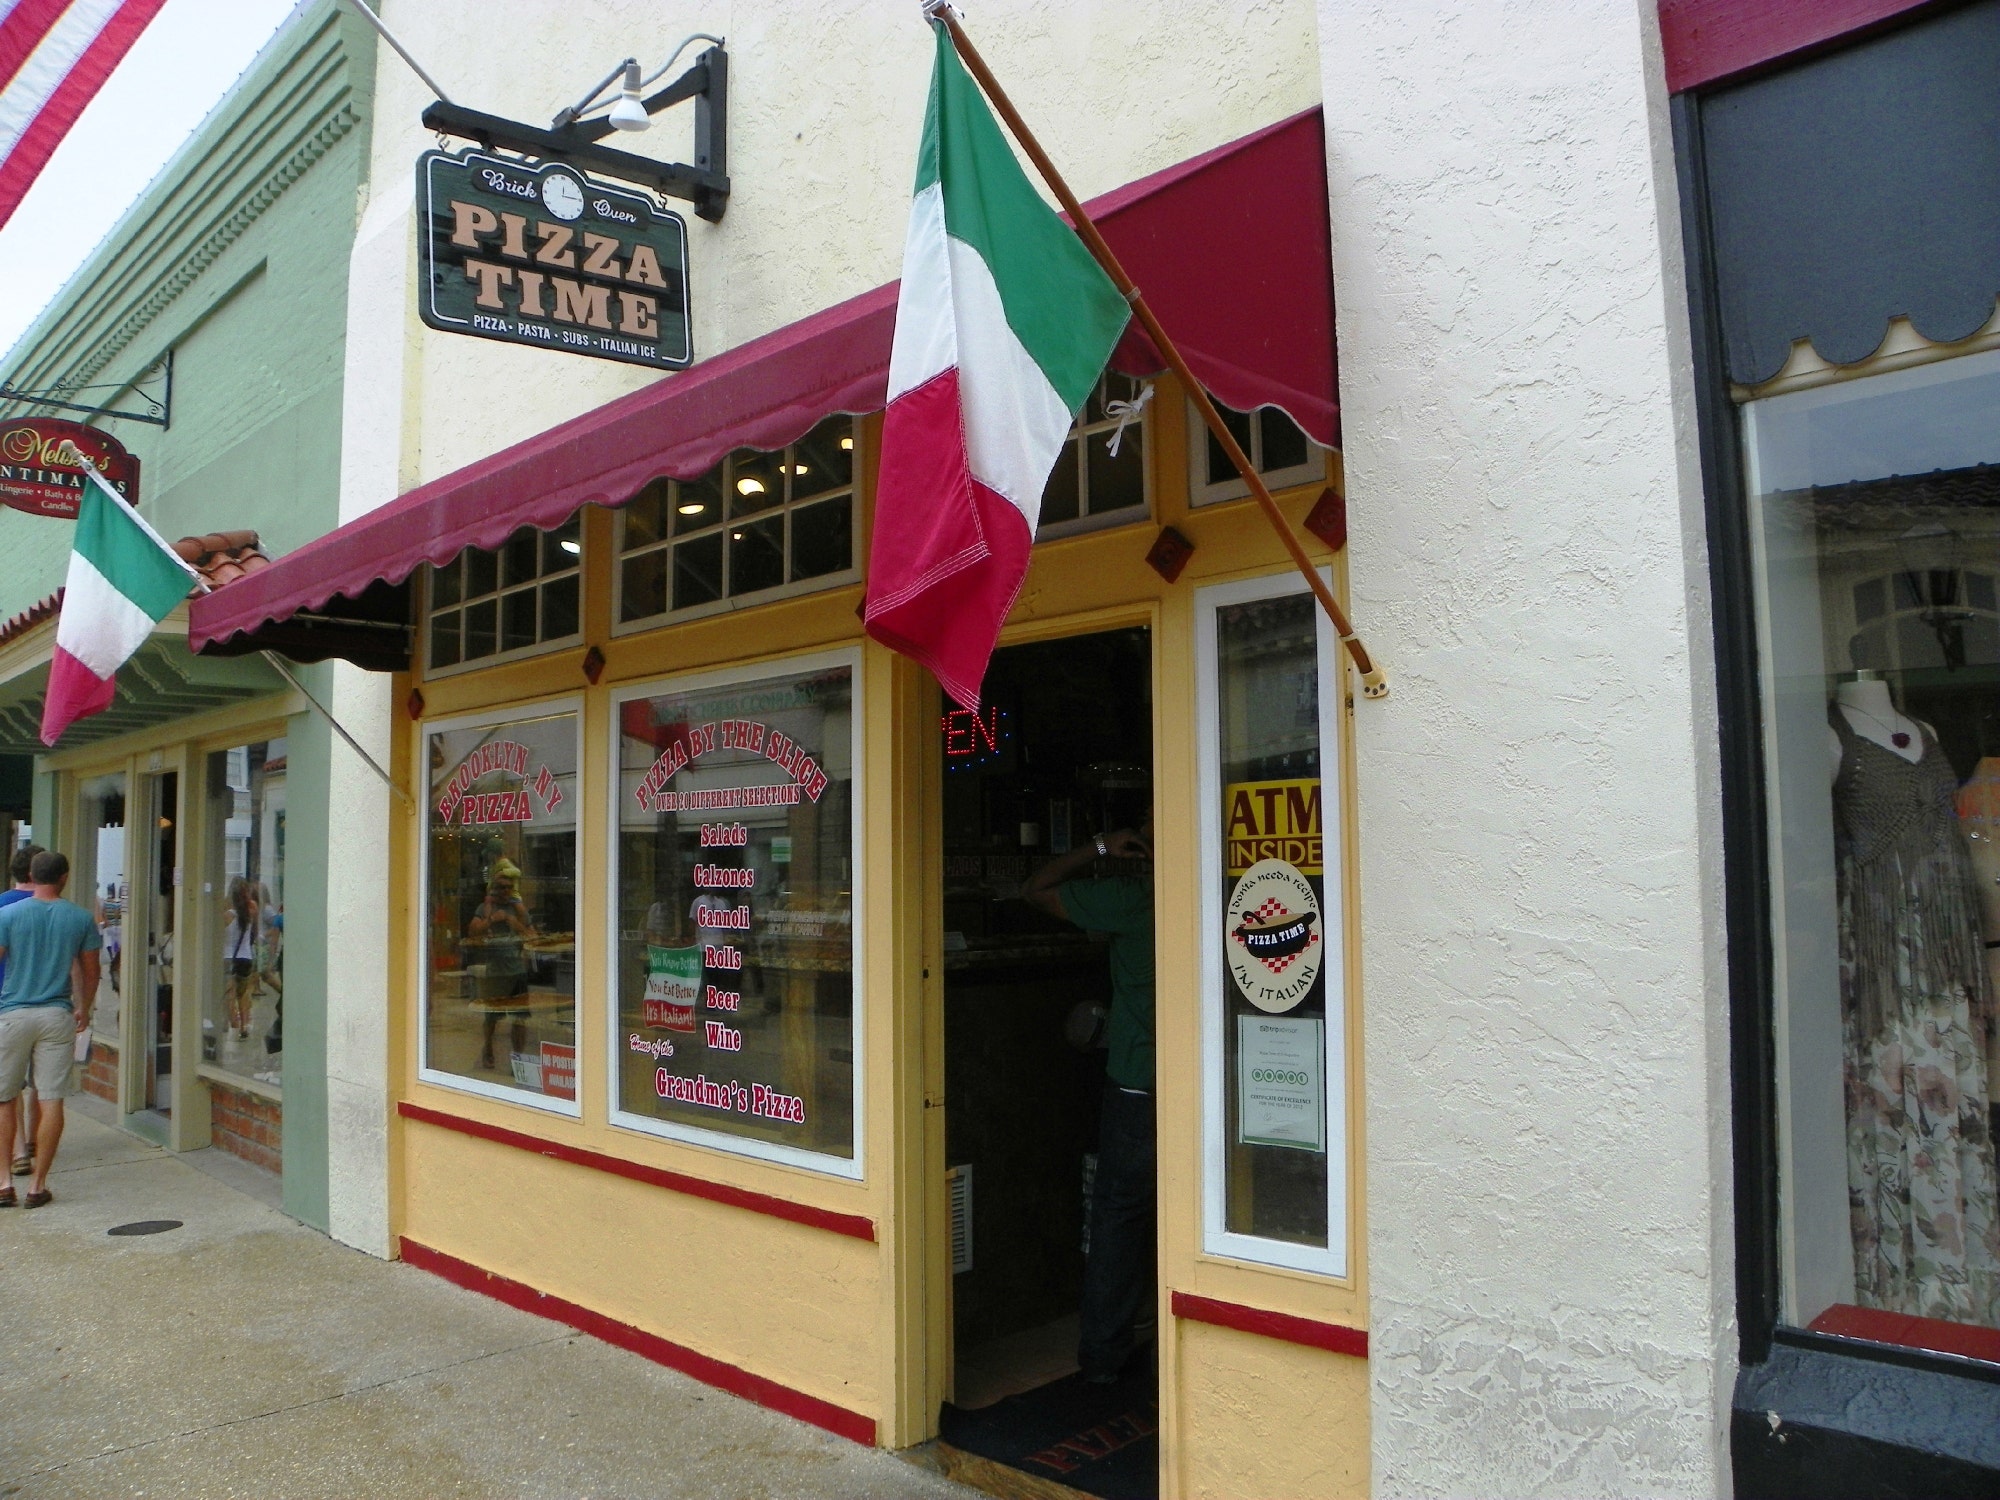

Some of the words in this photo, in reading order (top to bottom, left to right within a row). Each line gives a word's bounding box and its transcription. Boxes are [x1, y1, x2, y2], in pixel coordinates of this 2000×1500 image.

[482, 169, 537, 199] Brick
[593, 199, 637, 223] Oven
[451, 201, 667, 288] PIZZA
[466, 259, 658, 338] TIME
[474, 314, 507, 332] PIZZA
[518, 323, 551, 340] PASTA
[562, 331, 589, 346] SUBS
[600, 338, 637, 355] ITALIAN
[640, 345, 656, 358] ICE
[41, 500, 74, 512] Candles
[44, 490, 63, 499] Bath
[635, 740, 688, 813] PIZZA
[689, 722, 716, 758] BY
[722, 720, 765, 754] THE
[766, 730, 828, 803] SLICE
[534, 763, 563, 816] NY
[655, 792, 677, 812] OVER
[679, 791, 689, 811] 20
[690, 788, 741, 810] DIFFERENT
[742, 784, 801, 807] SELECTIONS
[461, 790, 533, 825] PIZZA
[1228, 785, 1322, 837] ATM
[700, 822, 747, 847] Salads
[1231, 840, 1323, 867] INSIDE
[694, 863, 754, 888] Calzones
[1292, 878, 1316, 909] recipe
[697, 905, 750, 929] Cannoli
[1248, 934, 1278, 945] PIZZA
[1279, 923, 1306, 942] TIME
[705, 945, 741, 970] Rolls
[664, 981, 674, 996] Eat
[1235, 965, 1254, 989] I'M
[1259, 965, 1315, 1000] ITALIAN
[706, 985, 740, 1011] Beer
[646, 1003, 658, 1021] It's
[661, 1003, 692, 1026] Italian!
[651, 1039, 661, 1060] of
[661, 1039, 674, 1057] the
[705, 1020, 741, 1051] Wine
[655, 1067, 748, 1113] Grandma's
[752, 1083, 805, 1124] Pizza
